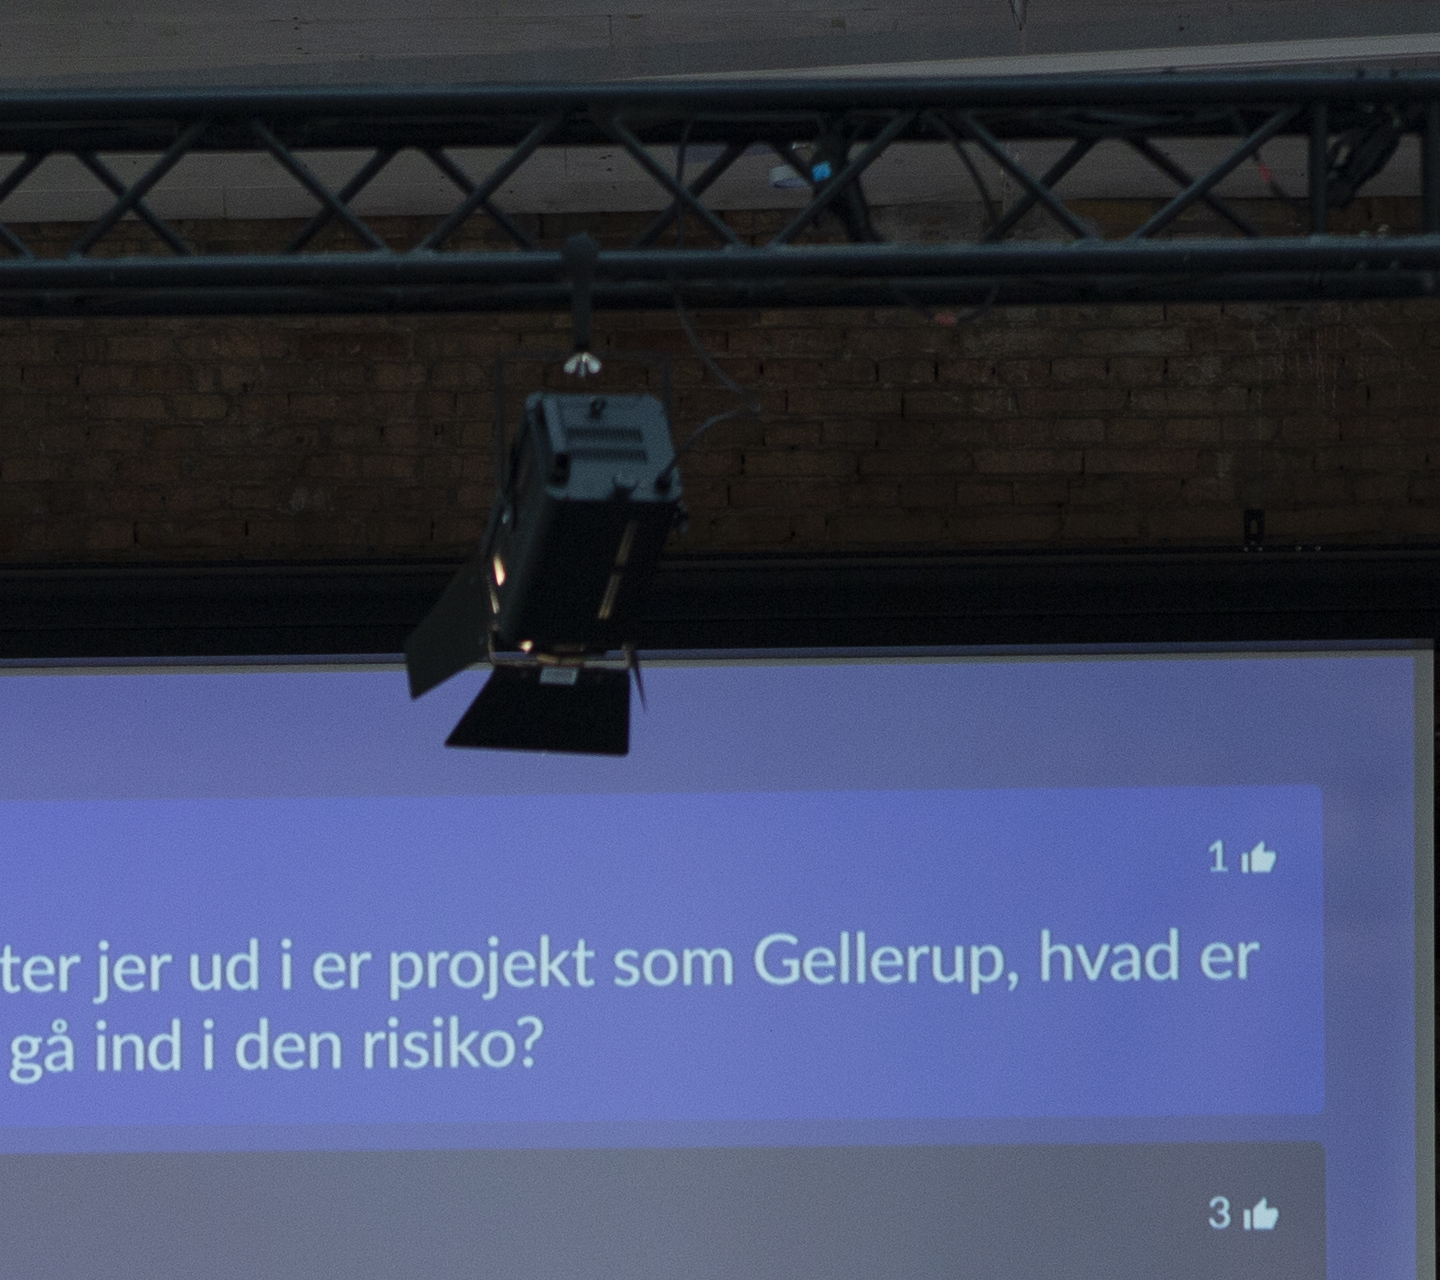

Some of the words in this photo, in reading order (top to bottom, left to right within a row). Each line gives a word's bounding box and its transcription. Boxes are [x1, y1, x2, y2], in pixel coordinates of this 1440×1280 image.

[1208, 839, 1229, 873] 1
[89, 938, 173, 1005] jer
[189, 937, 260, 993] ud
[280, 937, 293, 991] i
[312, 950, 373, 991] er
[389, 933, 596, 1002] projekt
[613, 947, 734, 988] som
[753, 930, 1019, 996] Gellerup,
[1040, 926, 1180, 983] hvad
[1200, 940, 1261, 981] er
[8, 1017, 75, 1086] gå
[95, 1017, 182, 1072] ind
[202, 1017, 215, 1071] i
[235, 1016, 342, 1071] den
[363, 1014, 544, 1070] risiko?
[1208, 1195, 1232, 1230] 3
